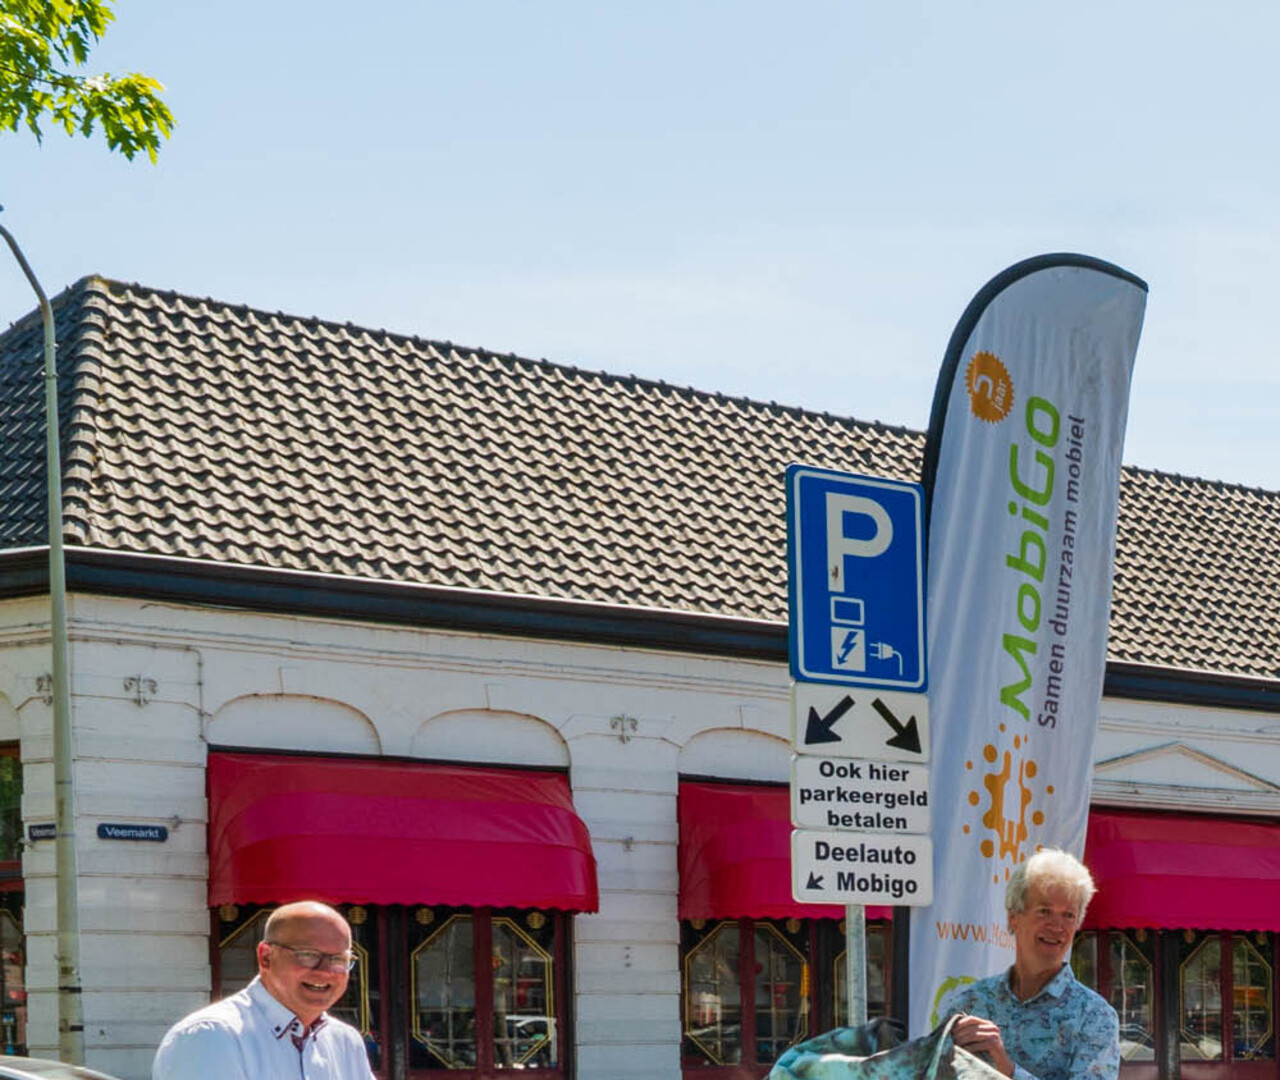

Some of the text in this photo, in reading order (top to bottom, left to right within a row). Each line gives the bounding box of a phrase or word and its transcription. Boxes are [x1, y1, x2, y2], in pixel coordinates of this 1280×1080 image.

[990, 378, 1007, 415] jaar
[1000, 396, 1060, 722] MobiGo
[1038, 415, 1085, 729] Samen duurzaam mobiel
[819, 760, 909, 782] Ook hier
[800, 786, 928, 809] parkeergeld
[105, 826, 160, 838] Veemarkt
[827, 810, 908, 830] betalen
[815, 841, 916, 865] Deelauto
[837, 871, 918, 898] Mobigo
